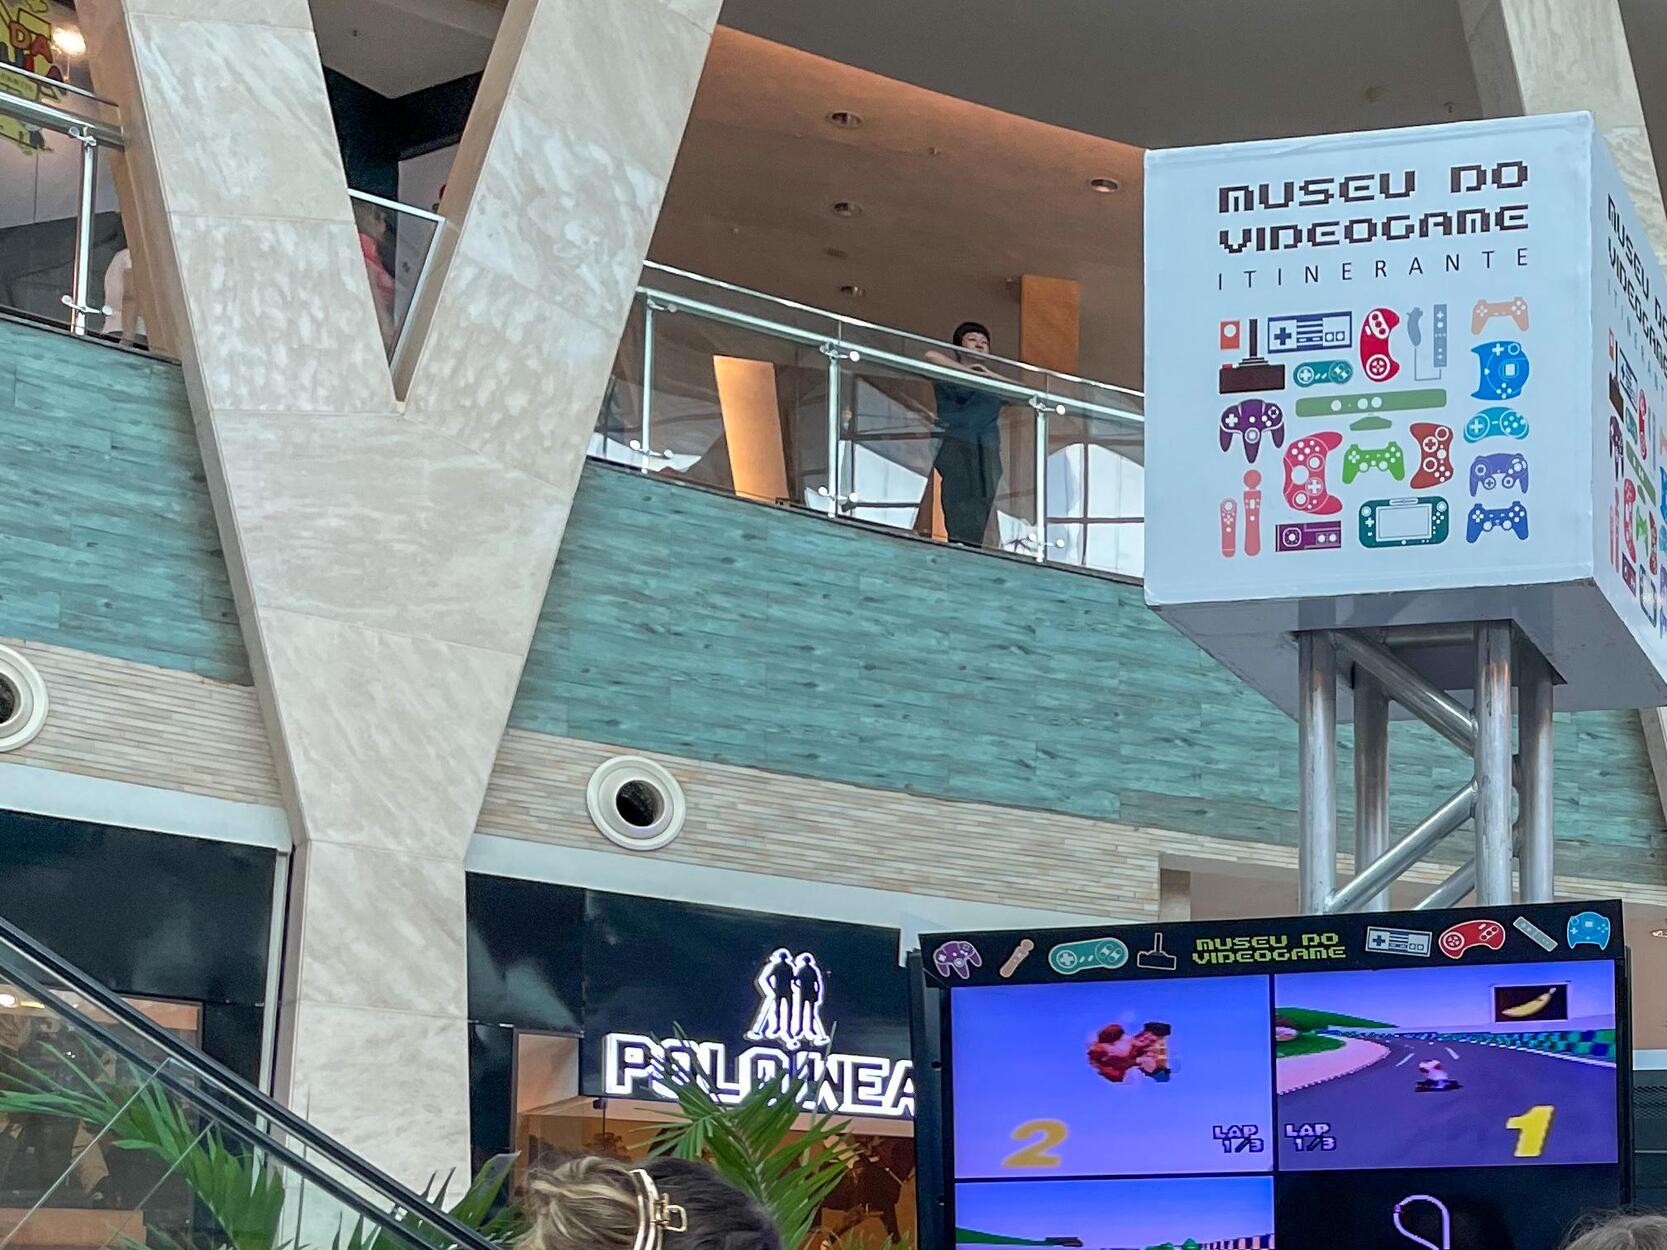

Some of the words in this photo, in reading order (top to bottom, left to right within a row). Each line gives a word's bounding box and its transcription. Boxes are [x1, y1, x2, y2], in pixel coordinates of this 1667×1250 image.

[1218, 169, 1417, 214] MUSEU
[1449, 160, 1529, 194] DO
[1218, 203, 1529, 255] VIDEOGAME
[1607, 192, 1650, 301] MUSEU
[1218, 247, 1529, 291] ITINERANTE
[1191, 945, 1347, 965] VIDEOGAME
[1195, 934, 1288, 951] MUSEU
[1301, 932, 1339, 946] DO
[1002, 1118, 1070, 1169] 2
[1212, 1125, 1259, 1139] LAP
[1222, 1138, 1264, 1153] 1/3
[1284, 1123, 1332, 1138] LAP
[1293, 1136, 1337, 1152] 1/3
[1504, 1104, 1555, 1158] 1
